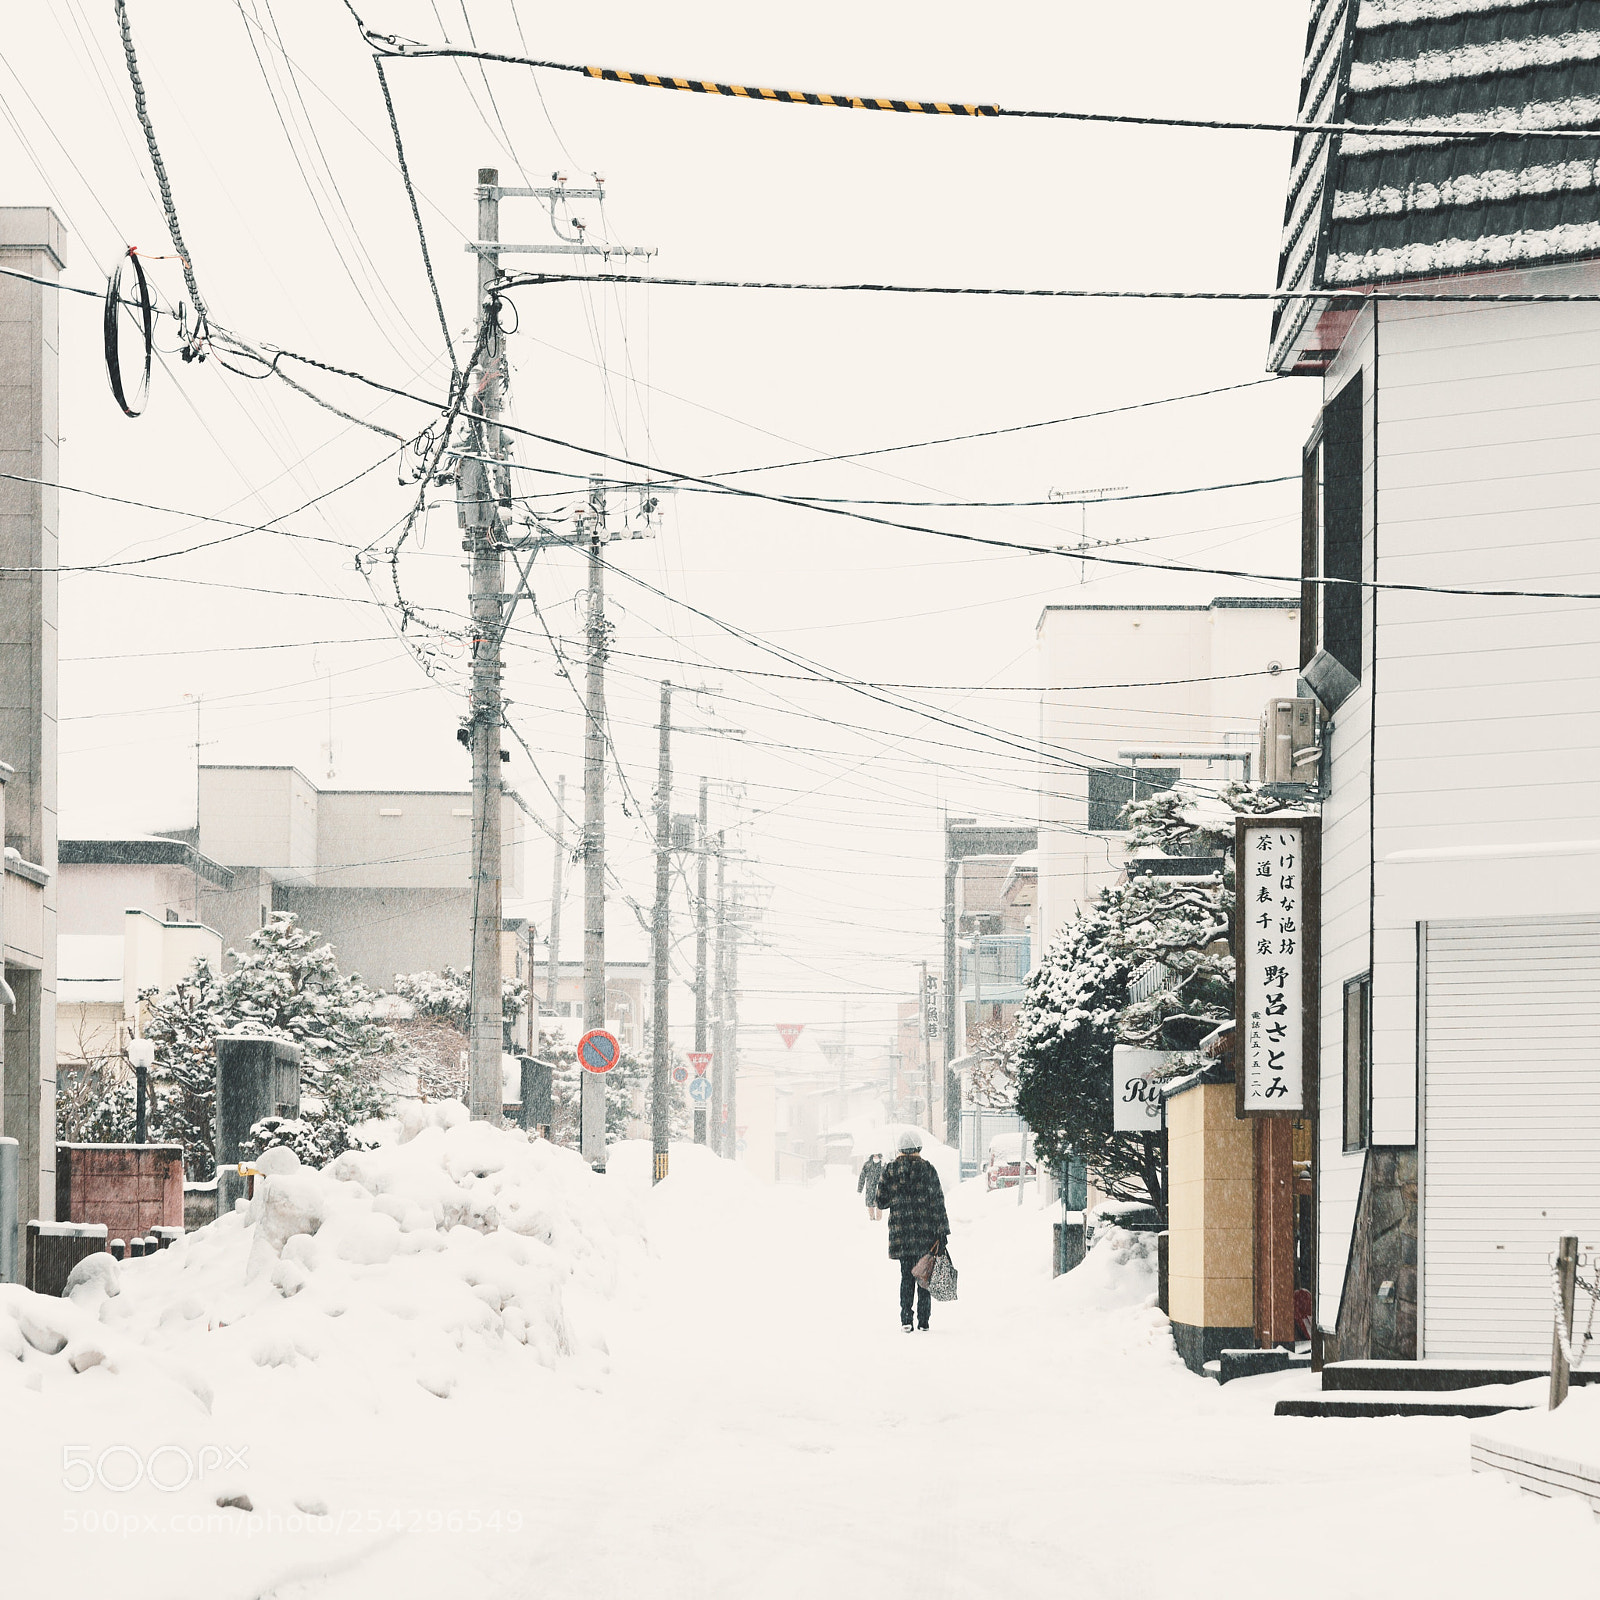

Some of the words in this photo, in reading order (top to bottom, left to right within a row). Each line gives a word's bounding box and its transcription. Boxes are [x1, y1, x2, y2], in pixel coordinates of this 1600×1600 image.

[1256, 834, 1273, 955] 茶道表千家
[1279, 834, 1297, 955] いけばな池坊
[1264, 965, 1289, 1099] 野呂さとみ
